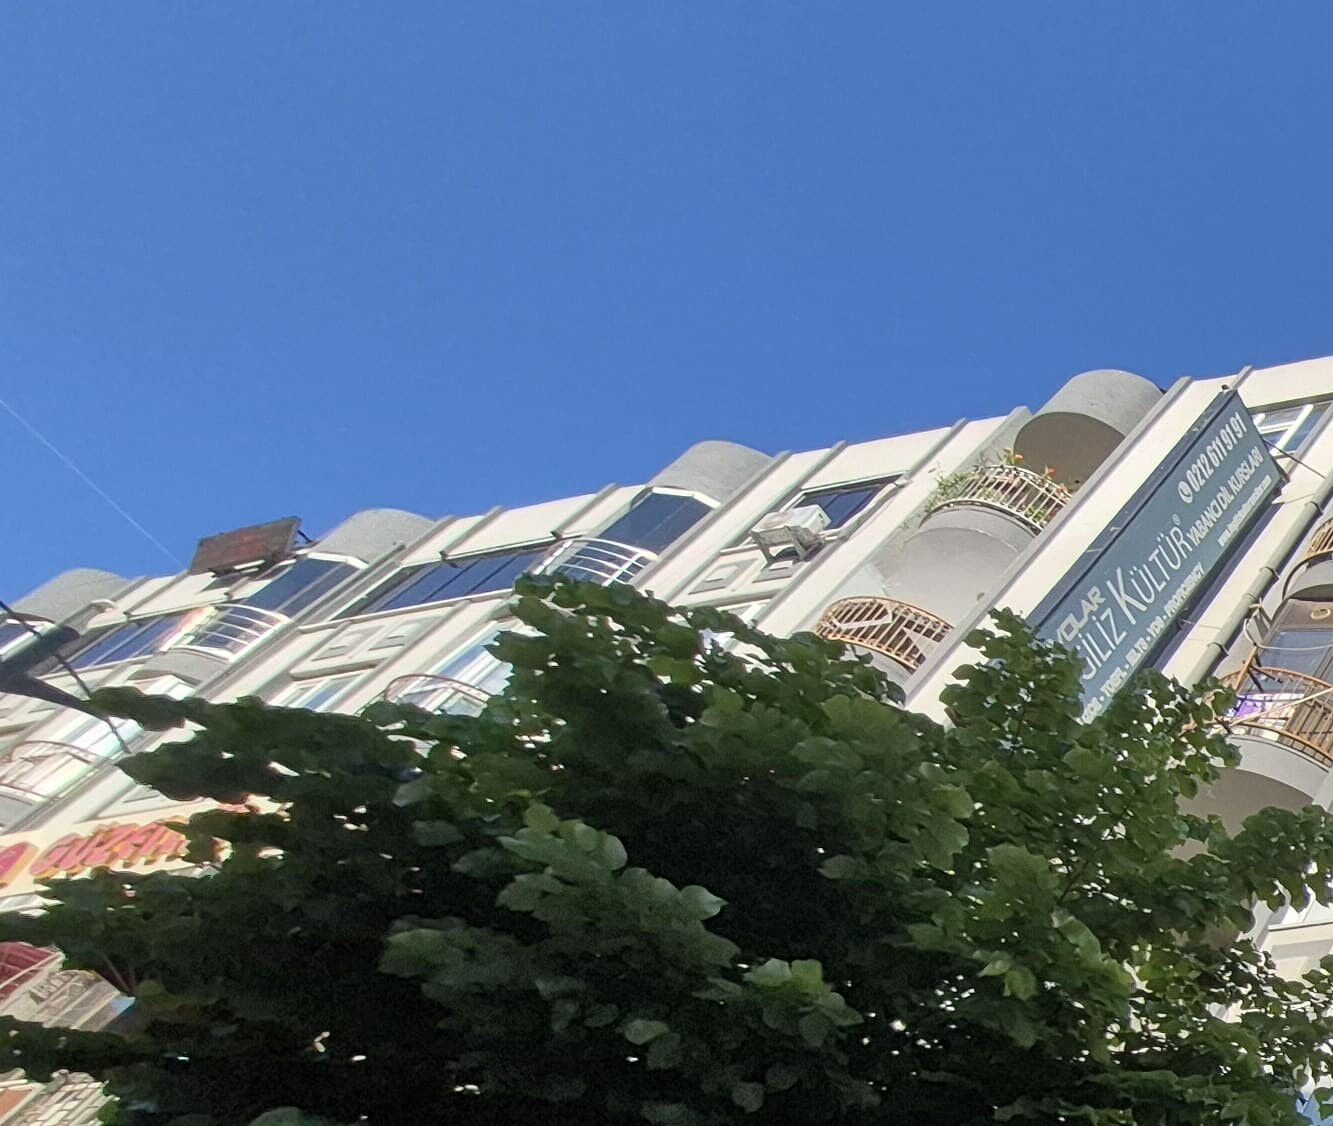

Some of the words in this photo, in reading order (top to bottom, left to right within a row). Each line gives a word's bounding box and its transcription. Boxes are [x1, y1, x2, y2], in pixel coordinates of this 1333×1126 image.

[1186, 454, 1214, 493] 0212
[1206, 436, 1228, 467] 611
[1220, 423, 1238, 450] 91
[1230, 412, 1247, 438] 91
[1186, 499, 1222, 546] YABANCI
[1228, 446, 1264, 495] KURSLARI
[1106, 525, 1194, 626] KÜLTÜR
